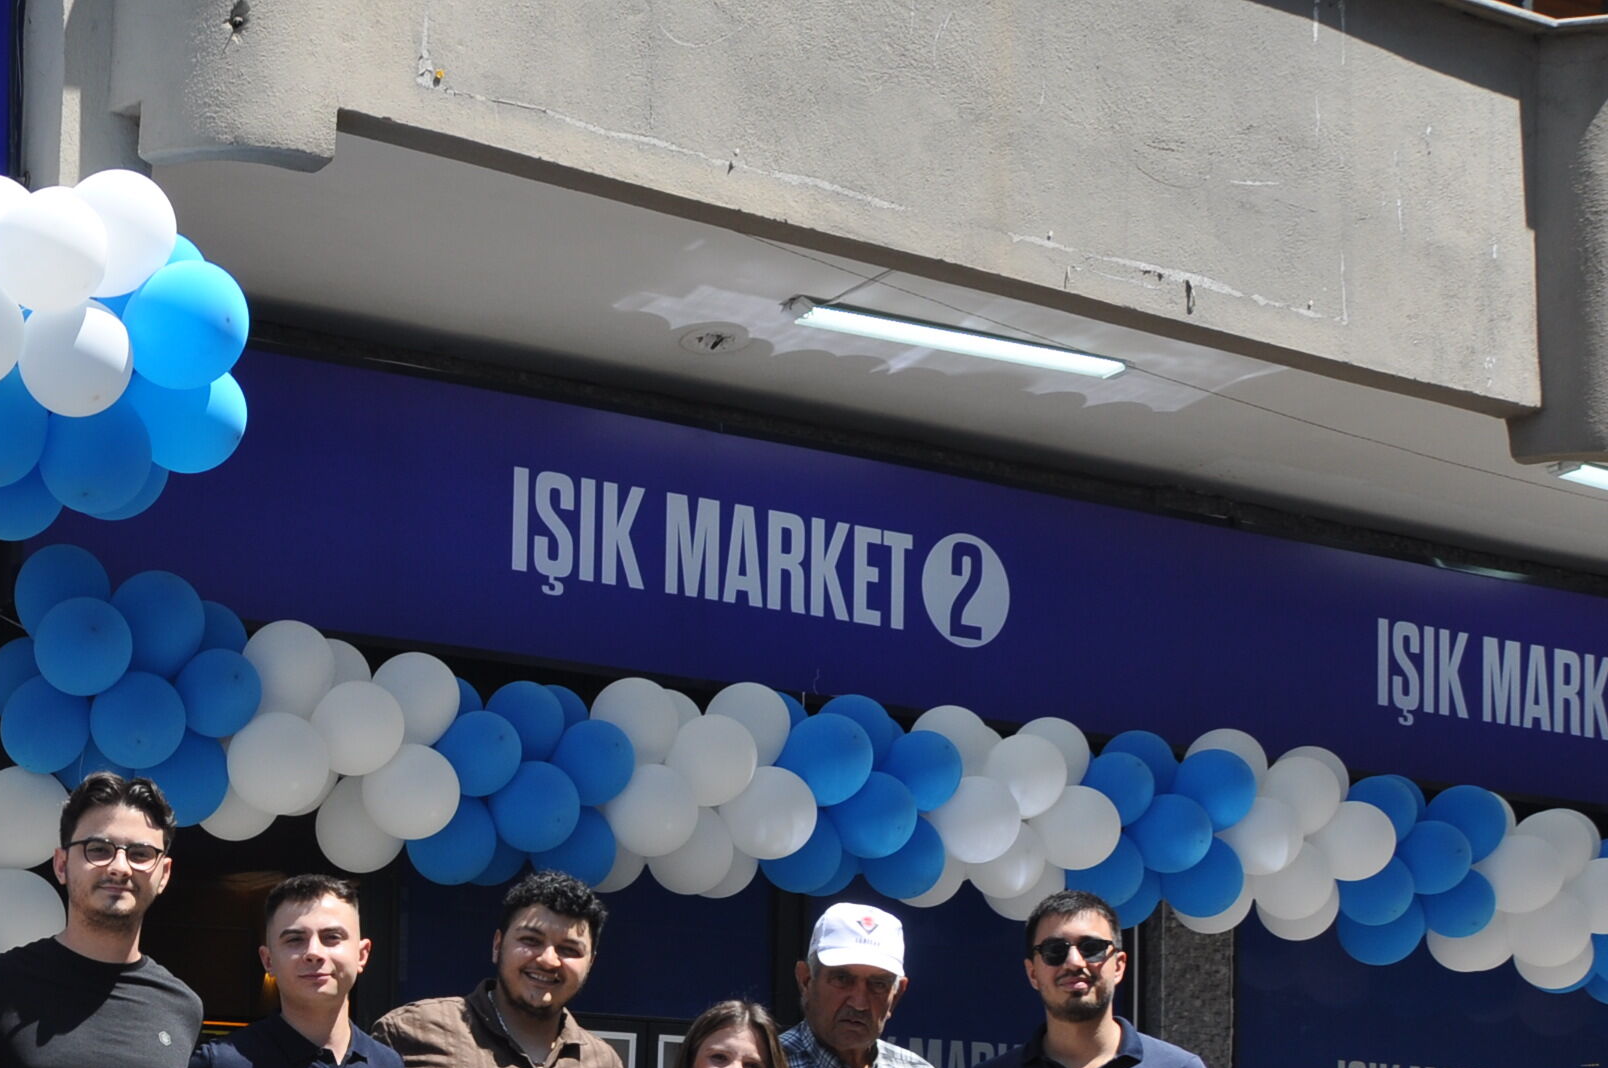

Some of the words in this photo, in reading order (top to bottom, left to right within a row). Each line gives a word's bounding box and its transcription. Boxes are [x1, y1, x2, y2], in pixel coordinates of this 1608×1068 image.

[511, 465, 646, 597] IŞIK
[664, 491, 914, 631] MARKET
[1377, 617, 1470, 727] IŞIK
